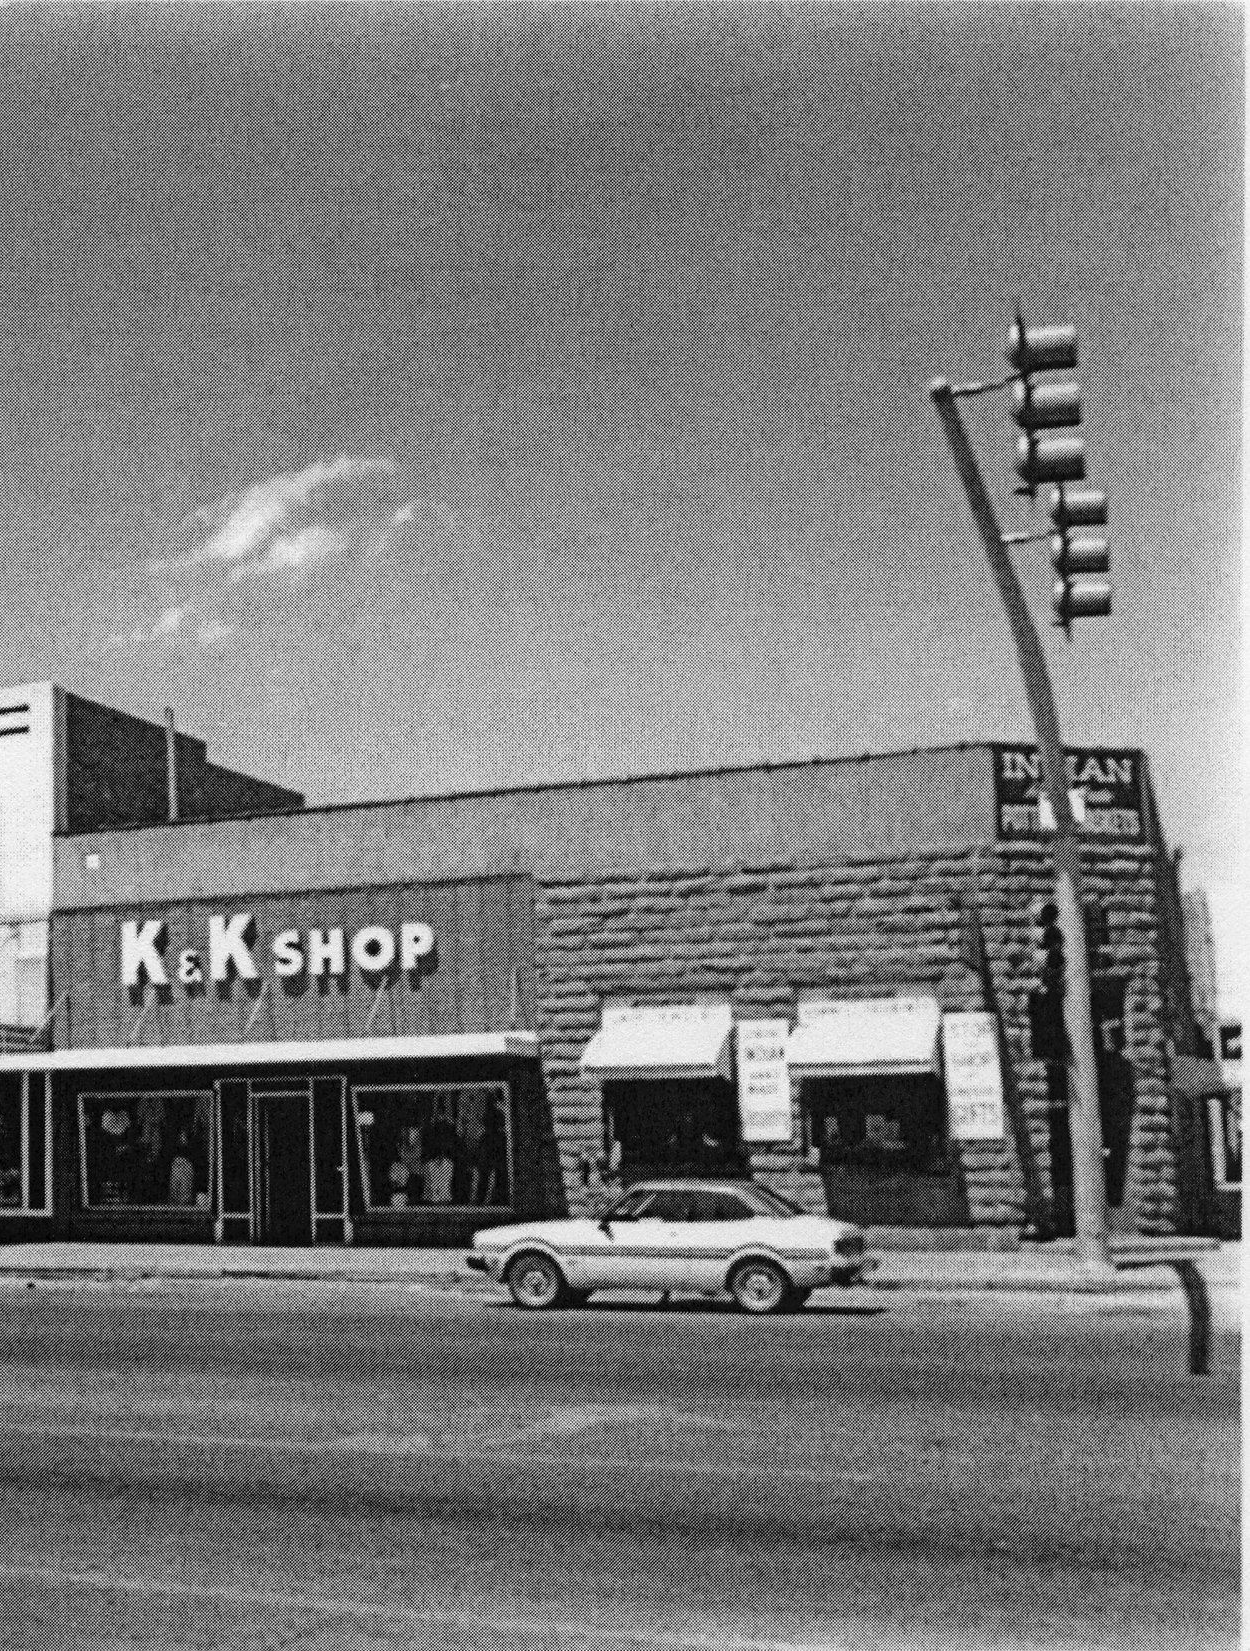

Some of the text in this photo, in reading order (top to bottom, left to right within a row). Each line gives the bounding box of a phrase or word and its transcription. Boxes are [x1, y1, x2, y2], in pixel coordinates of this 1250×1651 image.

[1002, 752, 1133, 783] INIAN
[121, 913, 435, 986] K & K SHOP
